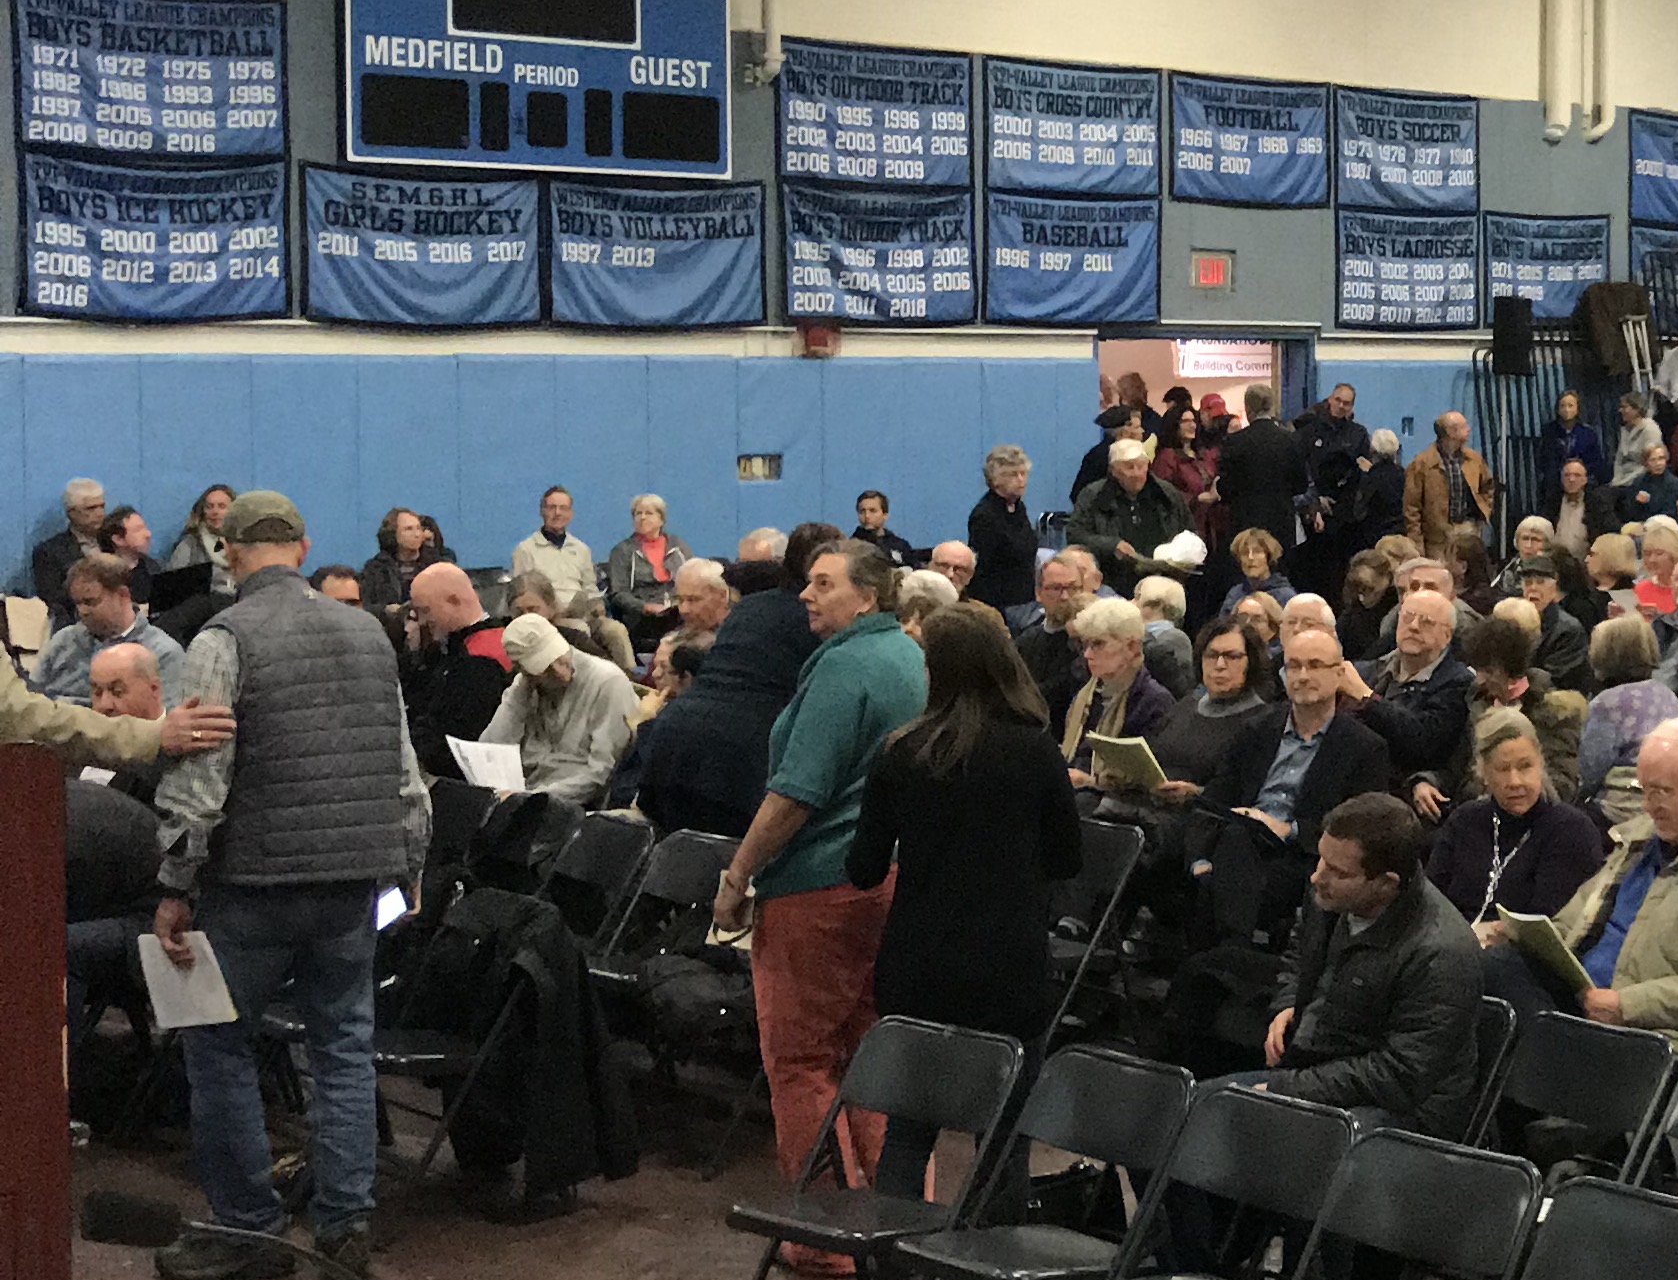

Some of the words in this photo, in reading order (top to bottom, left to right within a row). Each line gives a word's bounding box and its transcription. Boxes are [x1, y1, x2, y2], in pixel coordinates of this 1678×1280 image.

[26, 12, 91, 46] BOYS
[100, 21, 274, 57] BASKETBALL
[33, 44, 78, 68] 1971
[96, 54, 146, 77] 1972
[163, 60, 211, 80] 1975
[228, 61, 275, 80] 1976
[365, 34, 503, 73] MEDFIELD
[514, 63, 579, 87] PERIOD
[630, 56, 712, 89] GUEST
[33, 70, 81, 94] 1982
[163, 85, 213, 104] 1993
[229, 85, 276, 104] 1996
[786, 68, 827, 96] BOYS
[831, 73, 904, 103] OUTDOOR
[908, 81, 964, 106] TRACK
[32, 95, 81, 118] 1997
[96, 103, 152, 126] 2005
[161, 109, 216, 129] 2006
[226, 109, 278, 128] 2007
[788, 100, 827, 122] 1990
[837, 106, 873, 127] 1995
[884, 109, 920, 130] 1996
[932, 112, 965, 131] 1999
[993, 85, 1032, 112] BOYS
[1036, 91, 1082, 117] CROSS
[1085, 95, 1153, 119] COUNTRY
[993, 115, 1031, 136] 2000
[1038, 120, 1073, 141] 2003
[1080, 123, 1118, 142] 2004
[1123, 125, 1156, 143] 2005
[1203, 105, 1300, 132] FOOTBALL
[1356, 115, 1398, 140] BOYS
[1402, 121, 1461, 143] SOCCER
[29, 120, 87, 143] 2008
[96, 128, 153, 150] 2009
[166, 134, 216, 153] 2016
[786, 125, 827, 147] 2002
[835, 130, 875, 152] 2003
[883, 135, 923, 155] 2004
[931, 136, 967, 155] 2005
[1180, 128, 1212, 148] 1966
[1220, 134, 1248, 153] 1967
[1258, 137, 1288, 154] 1968
[1296, 137, 1323, 154] 1969
[787, 151, 829, 173] 2006
[837, 156, 877, 177] 2008
[885, 160, 924, 179] 2009
[993, 140, 1031, 160] 2006
[1039, 144, 1075, 165] 2009
[1084, 147, 1115, 165] 2010
[1127, 148, 1153, 166] 2011
[1178, 151, 1214, 172] 2006
[1220, 156, 1251, 175] 2007
[1414, 148, 1440, 165] 1977
[1448, 170, 1475, 186] 2010
[36, 186, 107, 220] BOYS
[115, 195, 159, 223] ICE
[169, 194, 275, 224] HOCKEY
[324, 199, 404, 232] GIRLS
[413, 208, 523, 236] HOCKEY
[35, 220, 87, 247] 1995
[101, 229, 155, 253] 2000
[169, 231, 218, 253] 2001
[229, 226, 279, 250] 2002
[558, 207, 613, 238] BOYS
[619, 214, 754, 241] VOLLEYBALL
[906, 218, 967, 242] TRACK
[1022, 222, 1128, 247] BASEBALL
[318, 232, 359, 256] 2011
[374, 239, 418, 262] 2015
[429, 242, 472, 263] 2016
[488, 241, 526, 262] 2017
[562, 242, 601, 263] 1997
[612, 246, 655, 267] 2013
[793, 241, 831, 261] 1995
[840, 246, 875, 267] 1996
[932, 247, 969, 266] 2002
[996, 247, 1030, 268] 1996
[1040, 252, 1071, 271] 1997
[1083, 254, 1112, 271] 2011
[1344, 234, 1386, 257] BOYS
[1391, 239, 1474, 258] LACROSSE
[34, 251, 91, 278] 2006
[102, 259, 155, 283] 2012
[168, 260, 217, 283] 2013
[229, 255, 280, 279] 2014
[1344, 259, 1374, 277] 2001
[1380, 262, 1408, 279] 2002
[1414, 264, 1444, 280] 2003
[37, 282, 88, 307] 2016
[838, 271, 881, 293] 2004
[886, 274, 925, 293] 2005
[933, 272, 970, 292] 2006
[1344, 281, 1376, 299] 2005
[1415, 286, 1444, 301] 2007
[793, 292, 834, 312] 2007
[844, 295, 877, 315] 2011
[1343, 303, 1375, 321] 2009
[1380, 306, 1411, 323] 2010
[1446, 306, 1473, 322] 2013
[1194, 361, 1233, 373] Building
